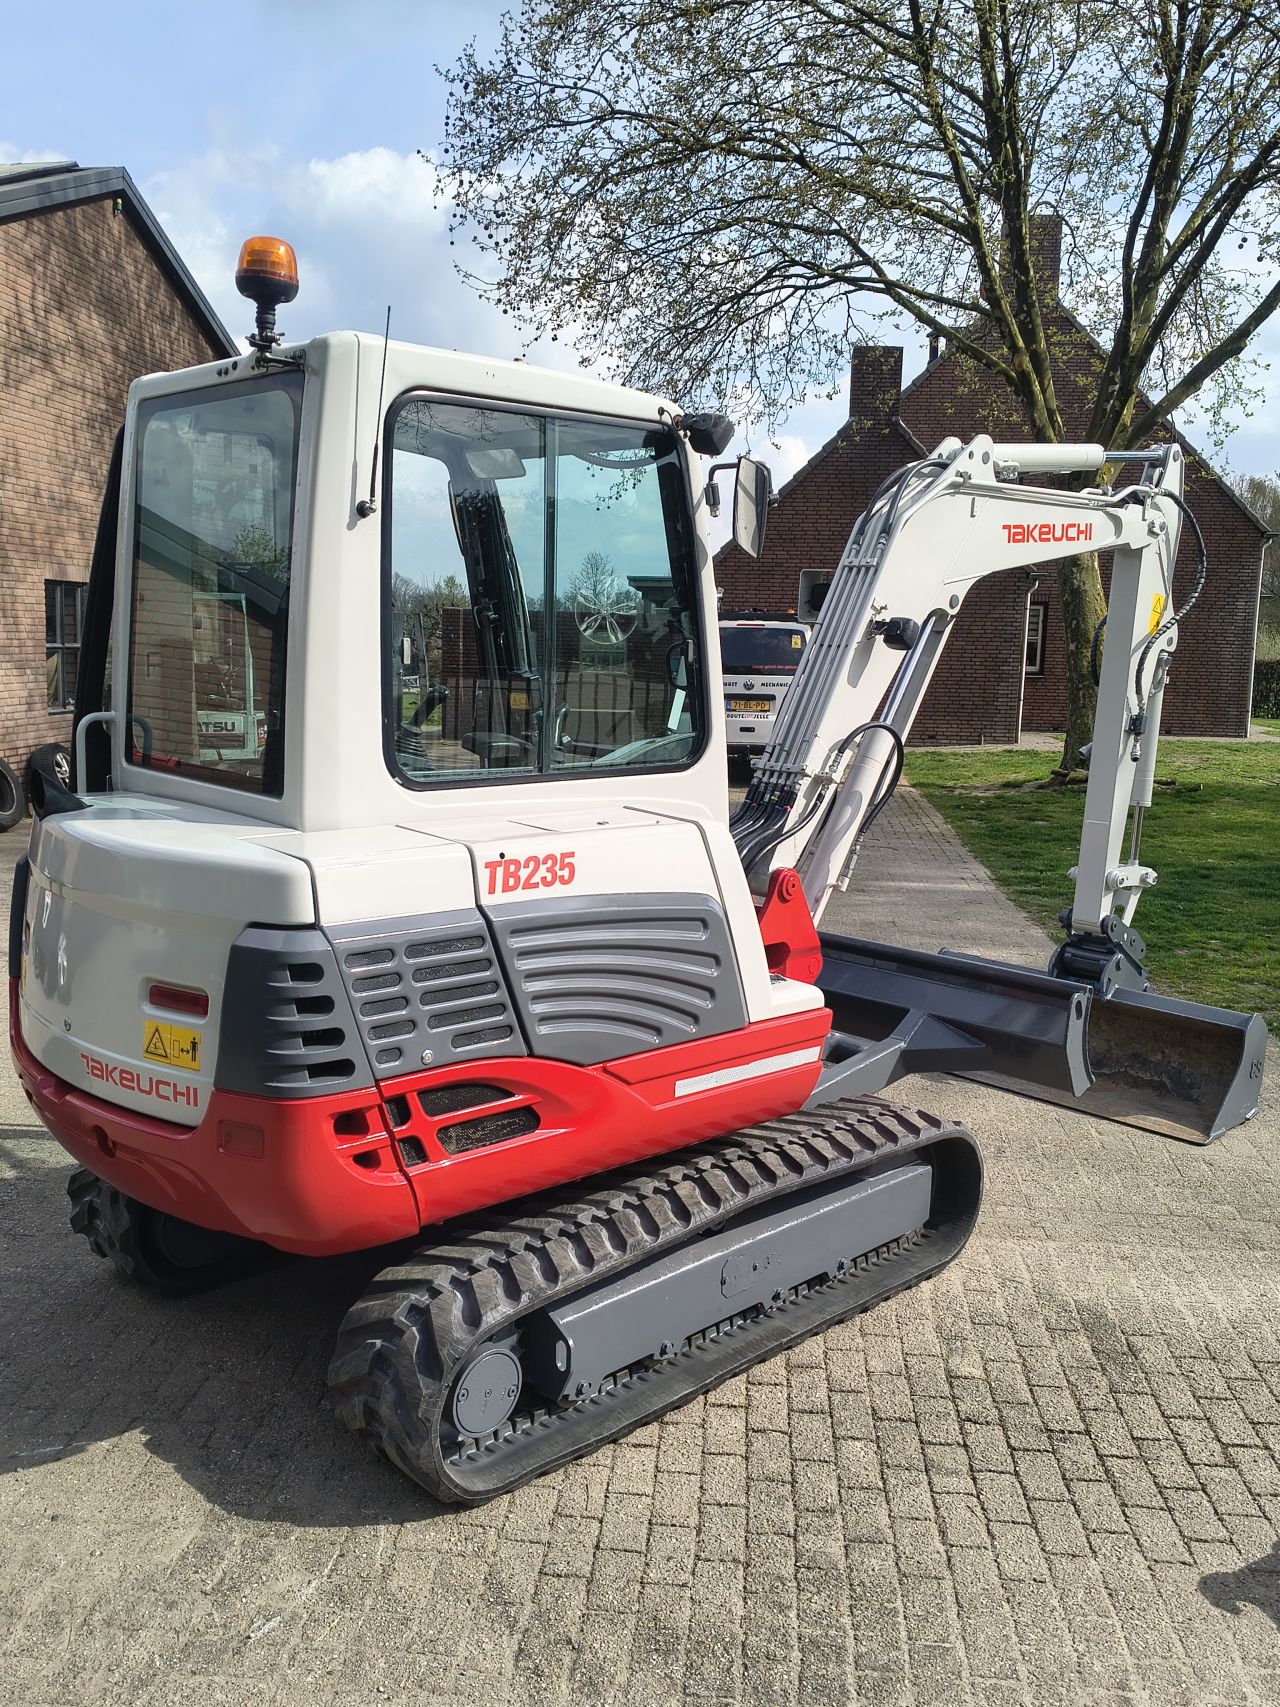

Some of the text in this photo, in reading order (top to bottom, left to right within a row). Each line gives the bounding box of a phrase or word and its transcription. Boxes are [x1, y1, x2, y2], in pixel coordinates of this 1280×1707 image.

[1002, 523, 1093, 544] TAKEUCHI
[484, 851, 576, 895] TB235
[80, 1052, 199, 1107] TAKEUCHI
